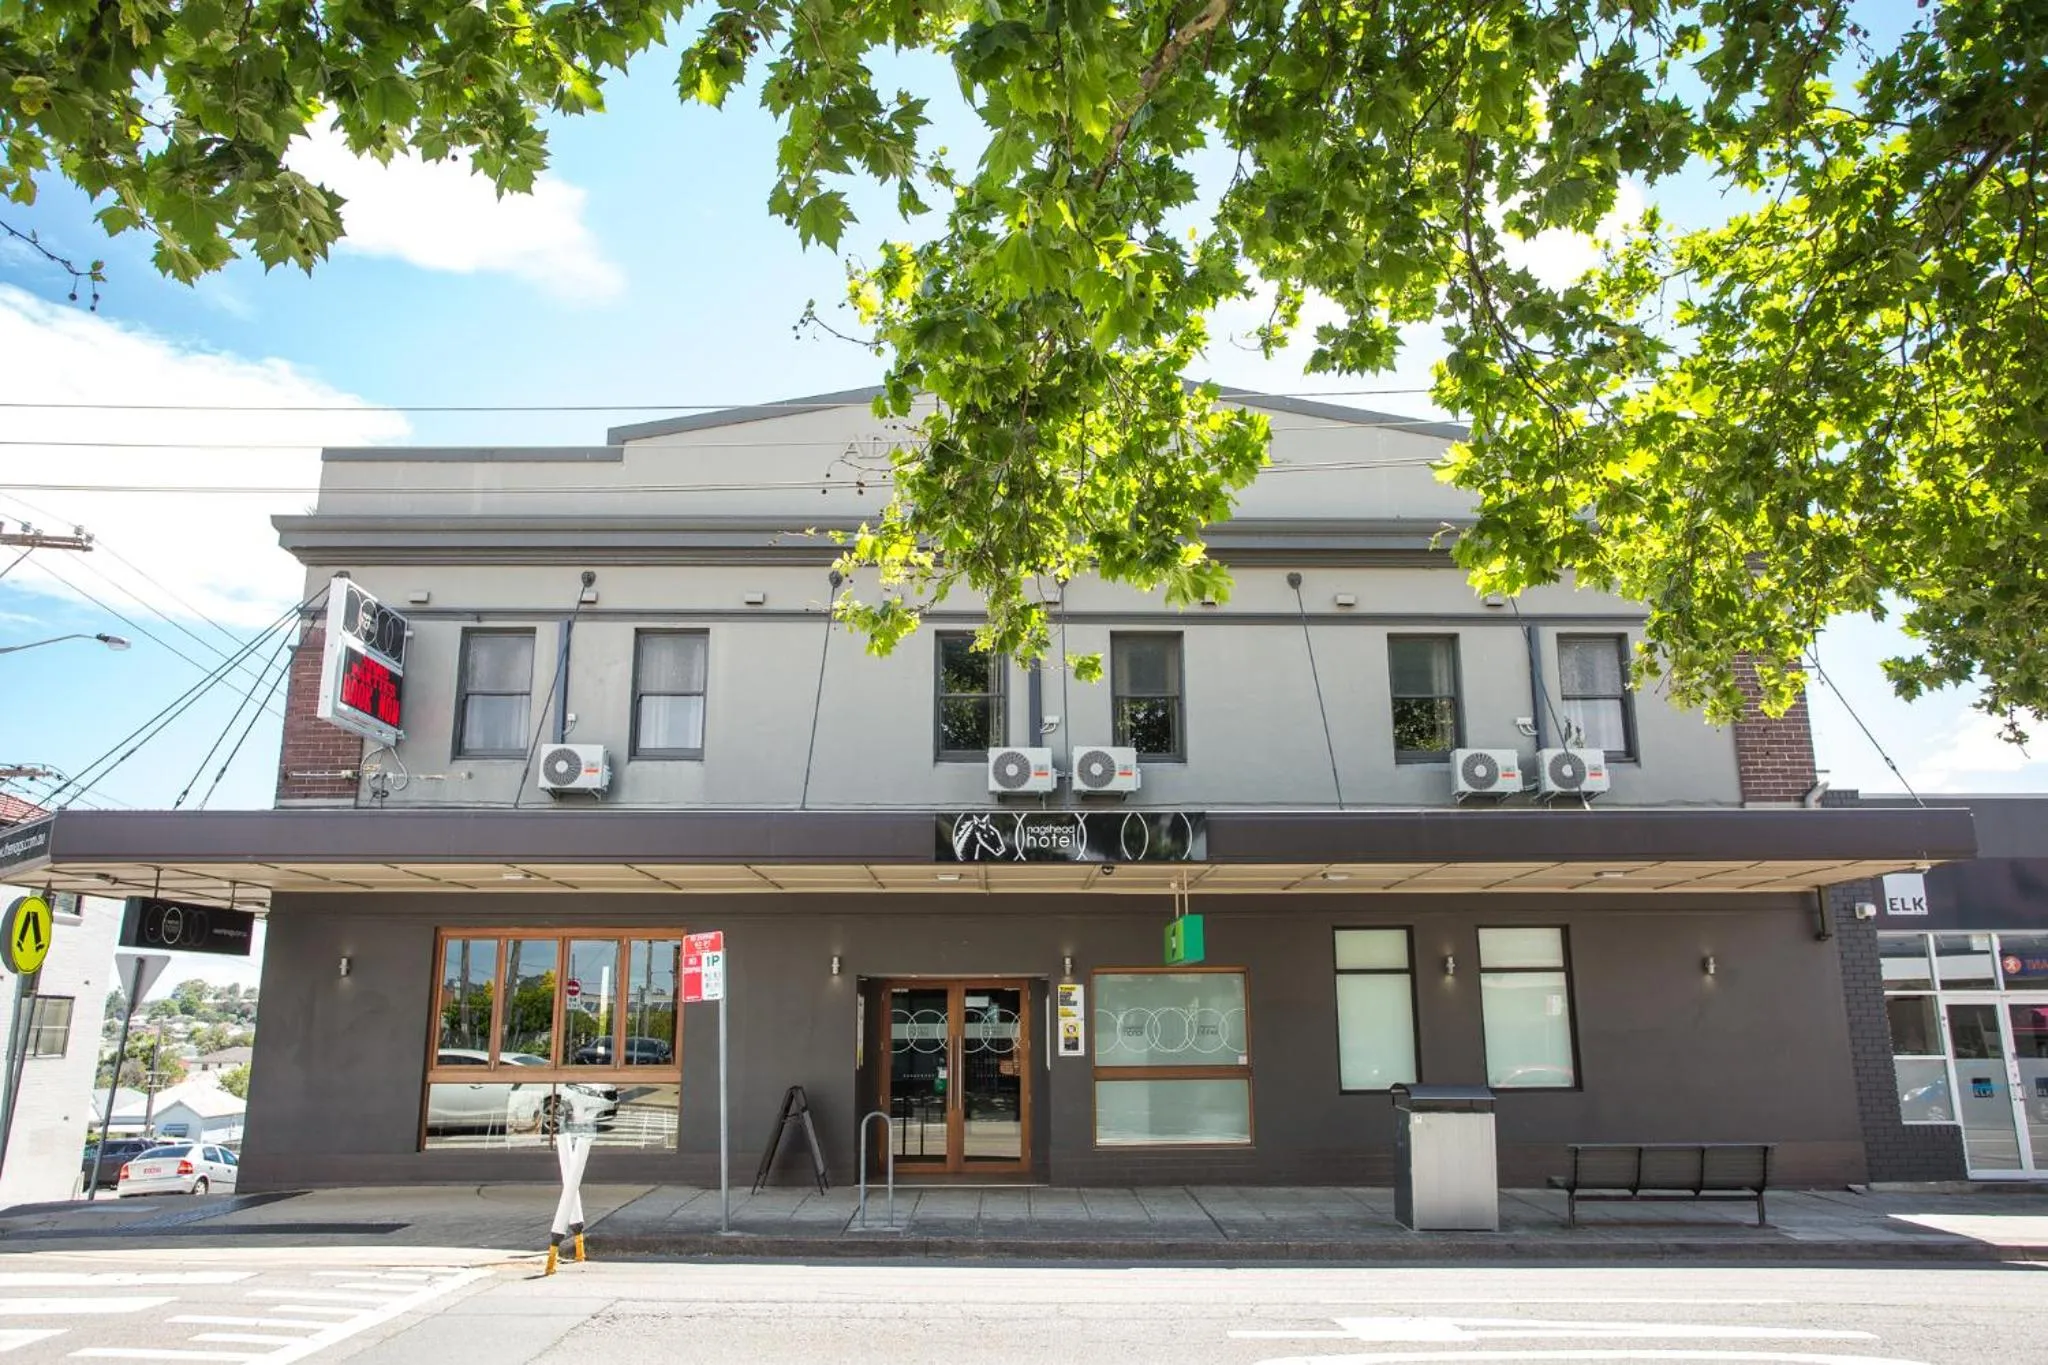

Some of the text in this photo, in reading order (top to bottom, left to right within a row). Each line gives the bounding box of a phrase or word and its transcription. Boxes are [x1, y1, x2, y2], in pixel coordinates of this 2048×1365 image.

[1026, 825, 1076, 836] nagshead
[1027, 833, 1076, 848] hotel
[1888, 897, 1925, 912] ELK
